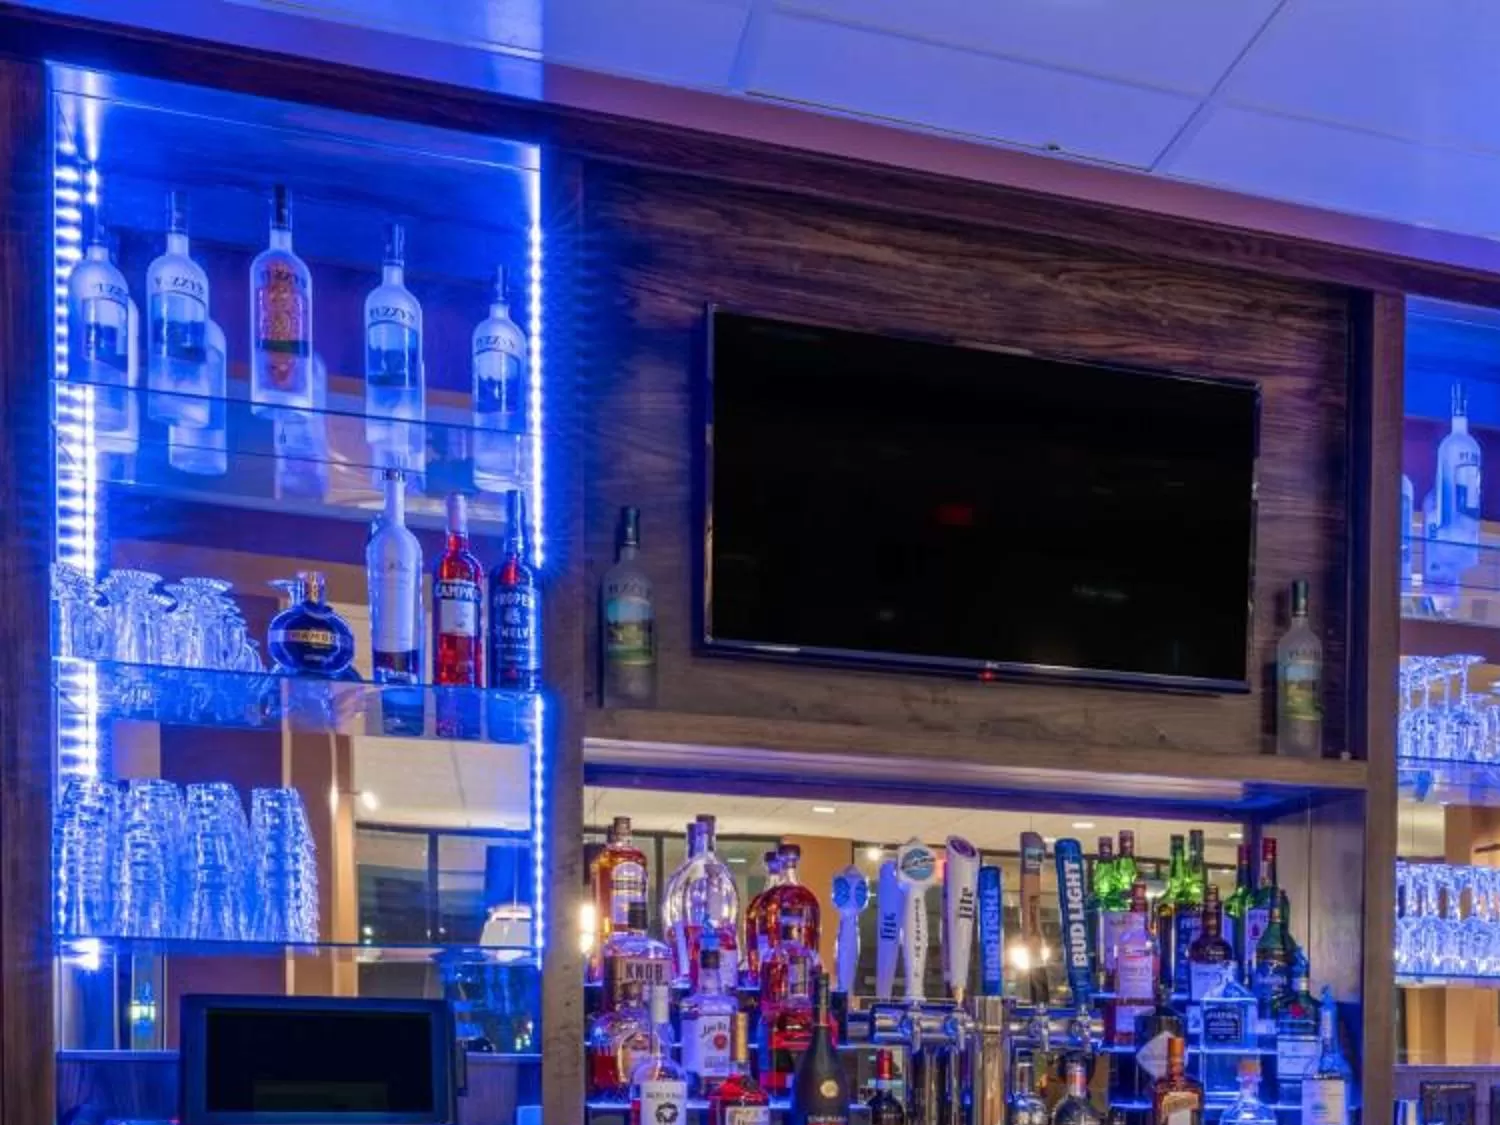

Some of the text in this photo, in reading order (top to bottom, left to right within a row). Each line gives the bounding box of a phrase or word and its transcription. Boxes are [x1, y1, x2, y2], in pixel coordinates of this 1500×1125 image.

[1063, 859, 1089, 968] BUD LIGHT
[625, 963, 664, 982] KNOB
